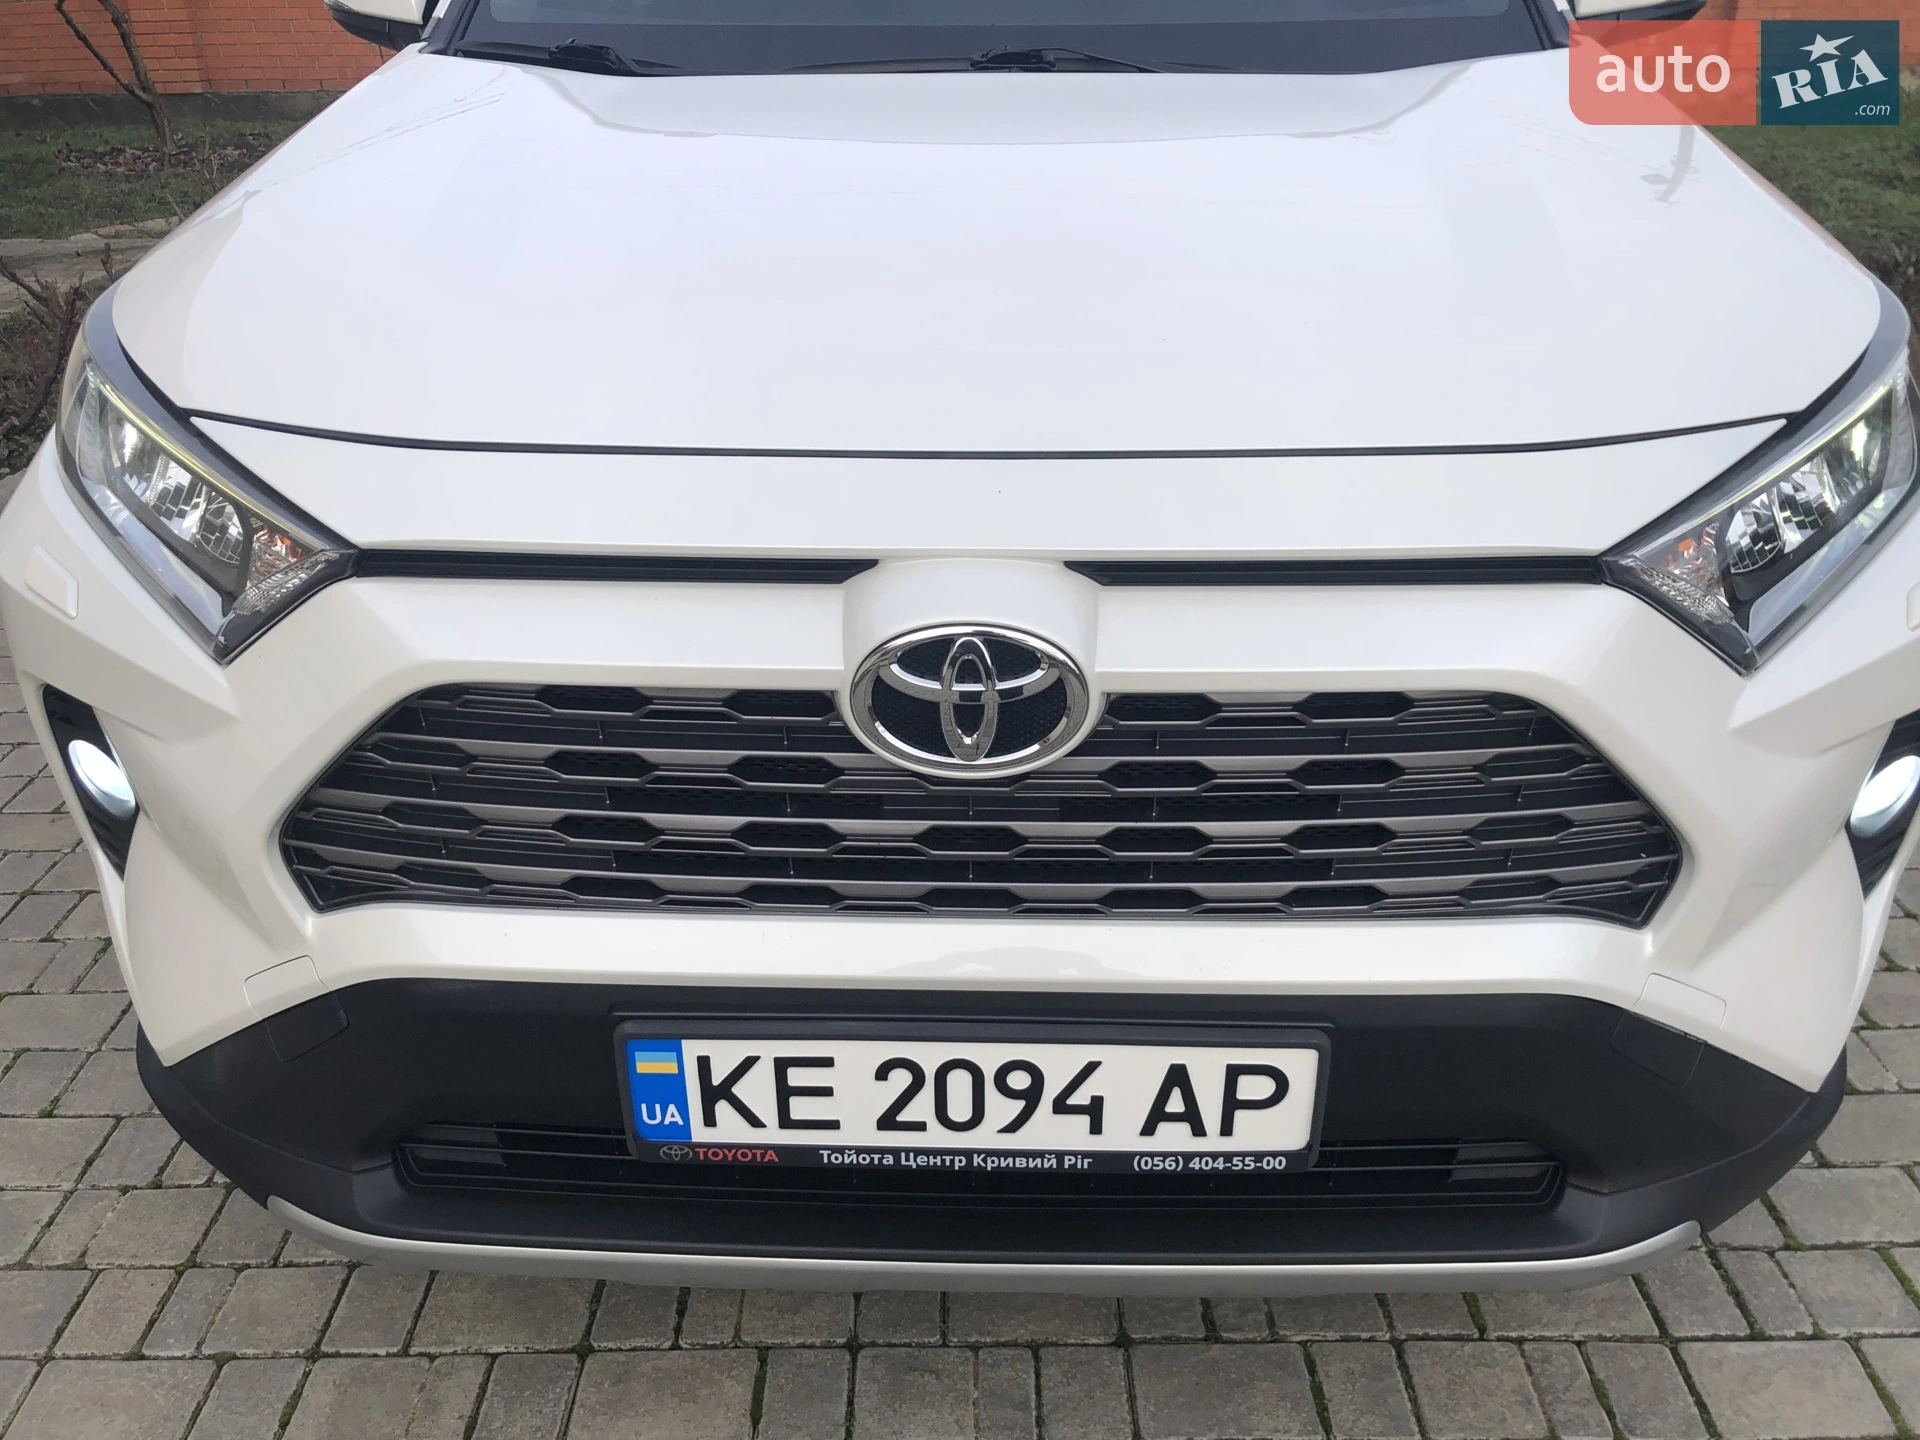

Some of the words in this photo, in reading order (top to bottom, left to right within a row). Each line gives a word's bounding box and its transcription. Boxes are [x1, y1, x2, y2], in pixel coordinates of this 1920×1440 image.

[696, 1055, 841, 1130] KE
[874, 1057, 1105, 1136] 2094
[1139, 1063, 1290, 1137] AP
[641, 1103, 684, 1126] UA
[694, 1147, 779, 1163] TOYOTA
[819, 1150, 894, 1166] Тойота
[900, 1152, 966, 1170] Центр
[972, 1153, 1057, 1171] Кривий
[1064, 1155, 1093, 1170] Ріг
[1133, 1155, 1184, 1172] (056)
[1188, 1156, 1287, 1171] 404-55-00
